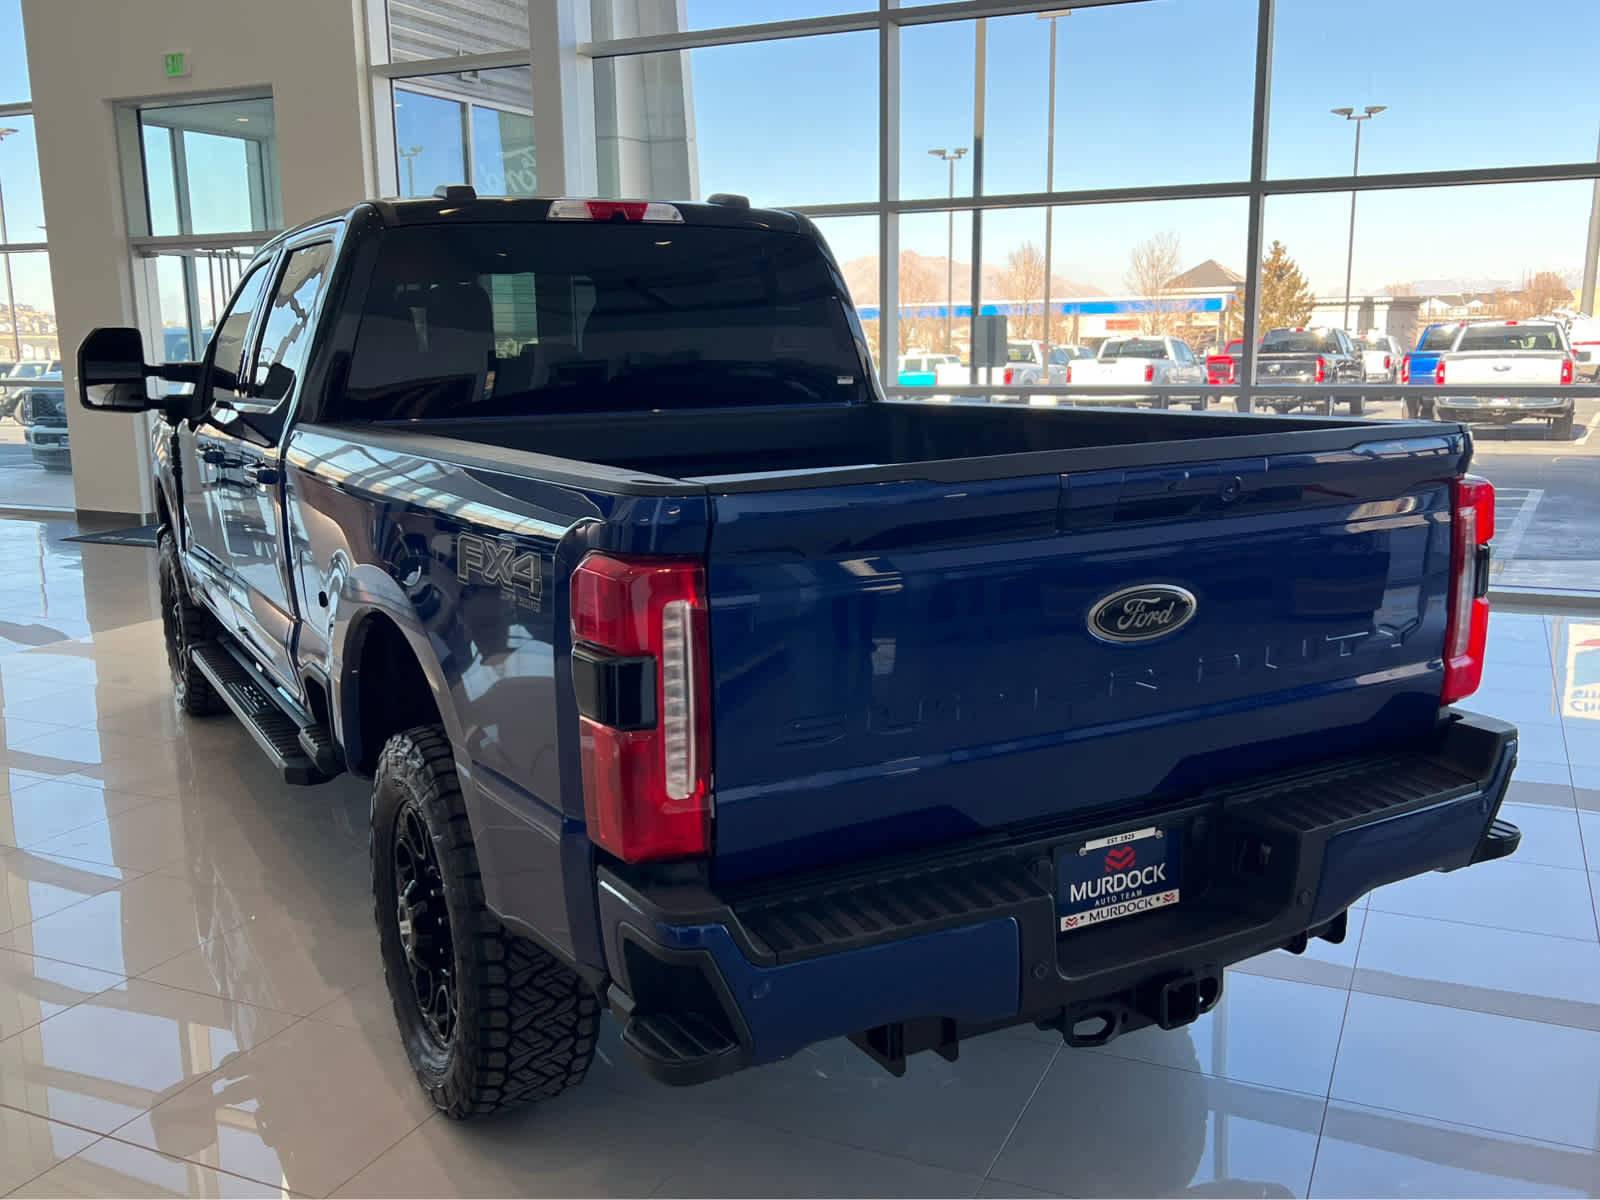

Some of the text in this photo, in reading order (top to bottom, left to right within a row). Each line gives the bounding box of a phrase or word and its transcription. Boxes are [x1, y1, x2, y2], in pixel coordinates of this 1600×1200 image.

[457, 531, 542, 601] FX4
[1117, 597, 1176, 630] Ford
[1070, 863, 1166, 902] MURDOCK
[1095, 889, 1143, 907] AUTO TEAM
[1089, 897, 1153, 922] MURDOCK
